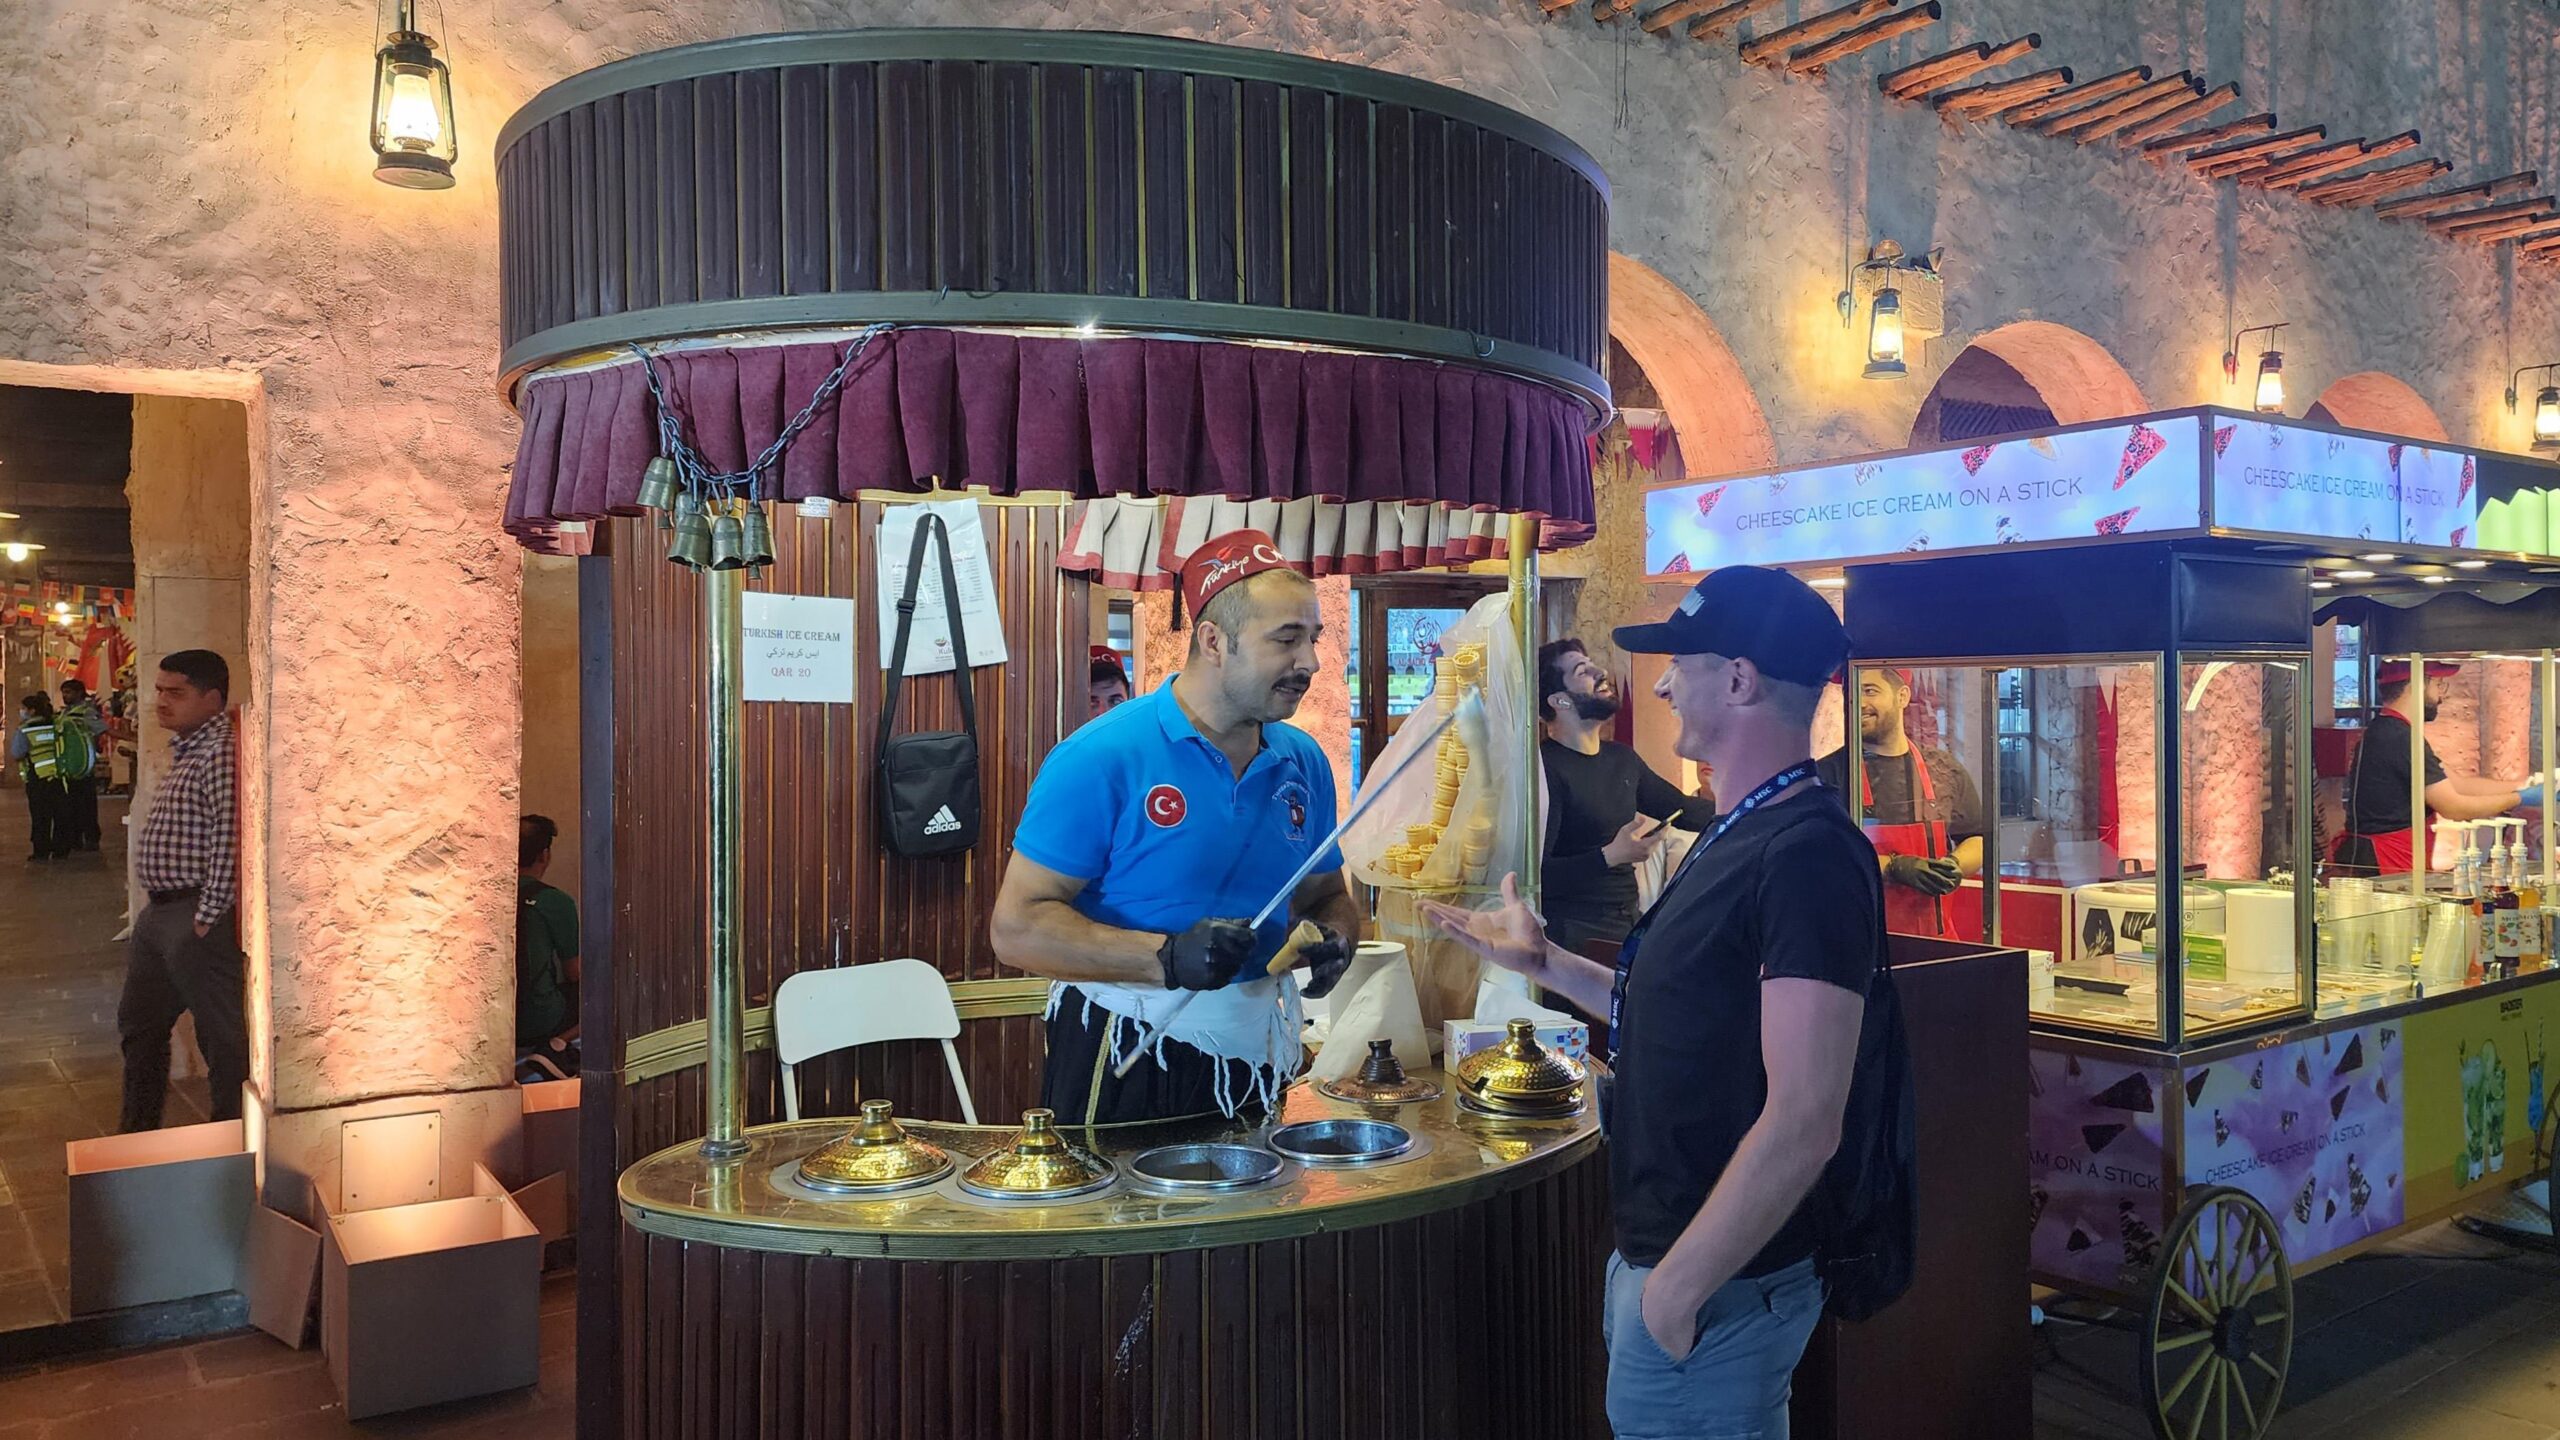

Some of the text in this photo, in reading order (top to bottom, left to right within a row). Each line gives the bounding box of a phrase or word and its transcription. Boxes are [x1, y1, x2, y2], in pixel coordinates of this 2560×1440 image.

[2243, 466, 2445, 506] CHEESCAKE ICE CREAM ON A STICK
[1736, 477, 2083, 531] CHEESCAKE ICE CREAM ON A STICK
[742, 627, 841, 642] TURKISH ICE CREAM
[771, 667, 812, 678] QAR 20
[1788, 768, 1806, 780] MSC
[1754, 786, 1773, 801] MSC
[1726, 809, 1741, 825] MSC
[924, 821, 962, 835] adidas
[2205, 1156, 2266, 1184] CHEESCAKE
[2318, 1134, 2331, 1149] ON
[2332, 1131, 2340, 1144] A
[2340, 1122, 2367, 1142] STICK
[2055, 1155, 2082, 1175] ON
[2087, 1162, 2099, 1178] A
[2104, 1166, 2159, 1191] STICK
